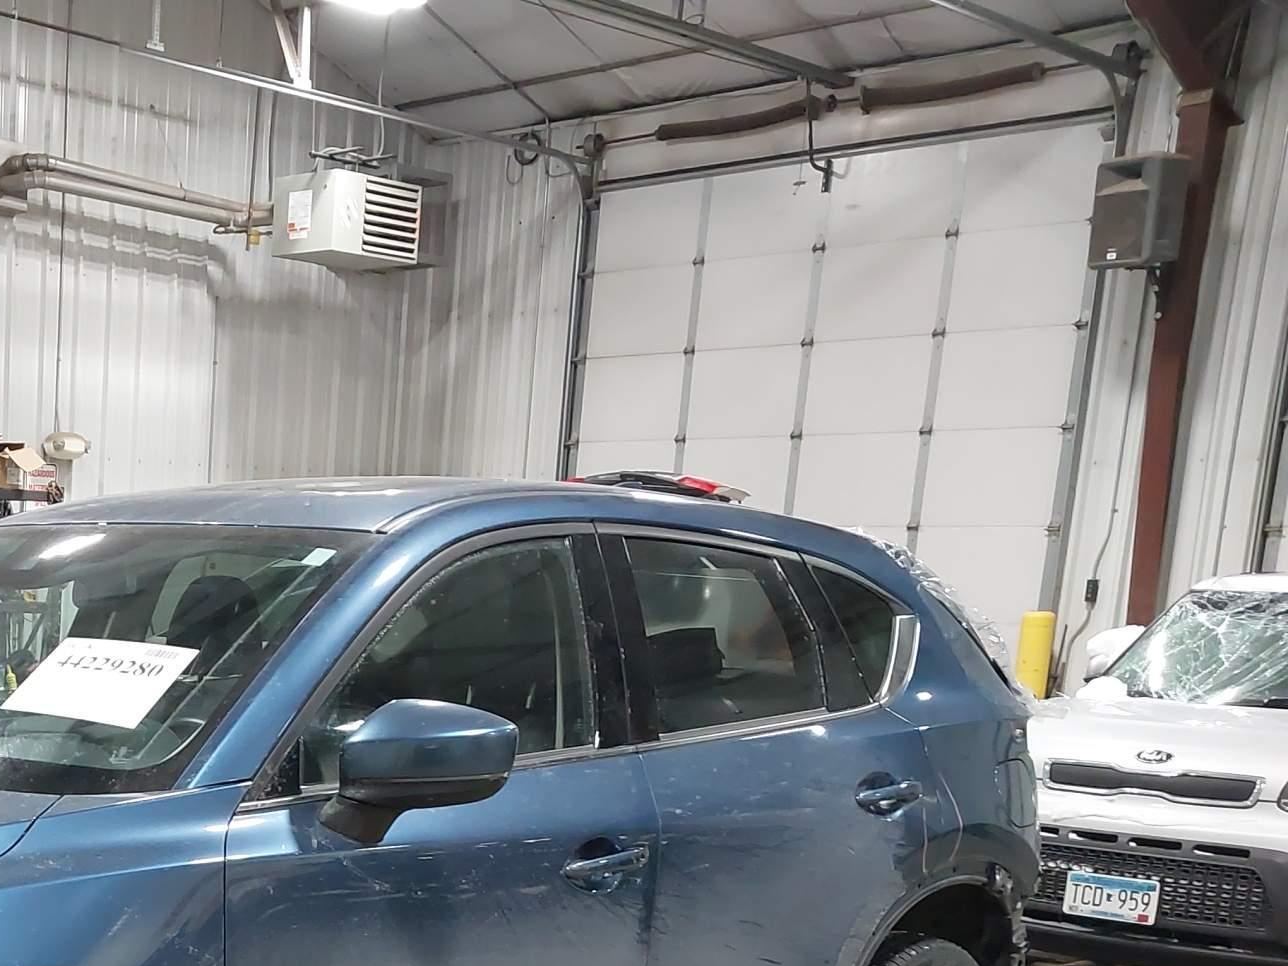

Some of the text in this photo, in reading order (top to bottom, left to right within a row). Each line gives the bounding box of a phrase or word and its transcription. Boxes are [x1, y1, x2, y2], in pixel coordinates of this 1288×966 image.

[57, 655, 165, 677] 44229280
[1072, 882, 1152, 914] TCD 959
